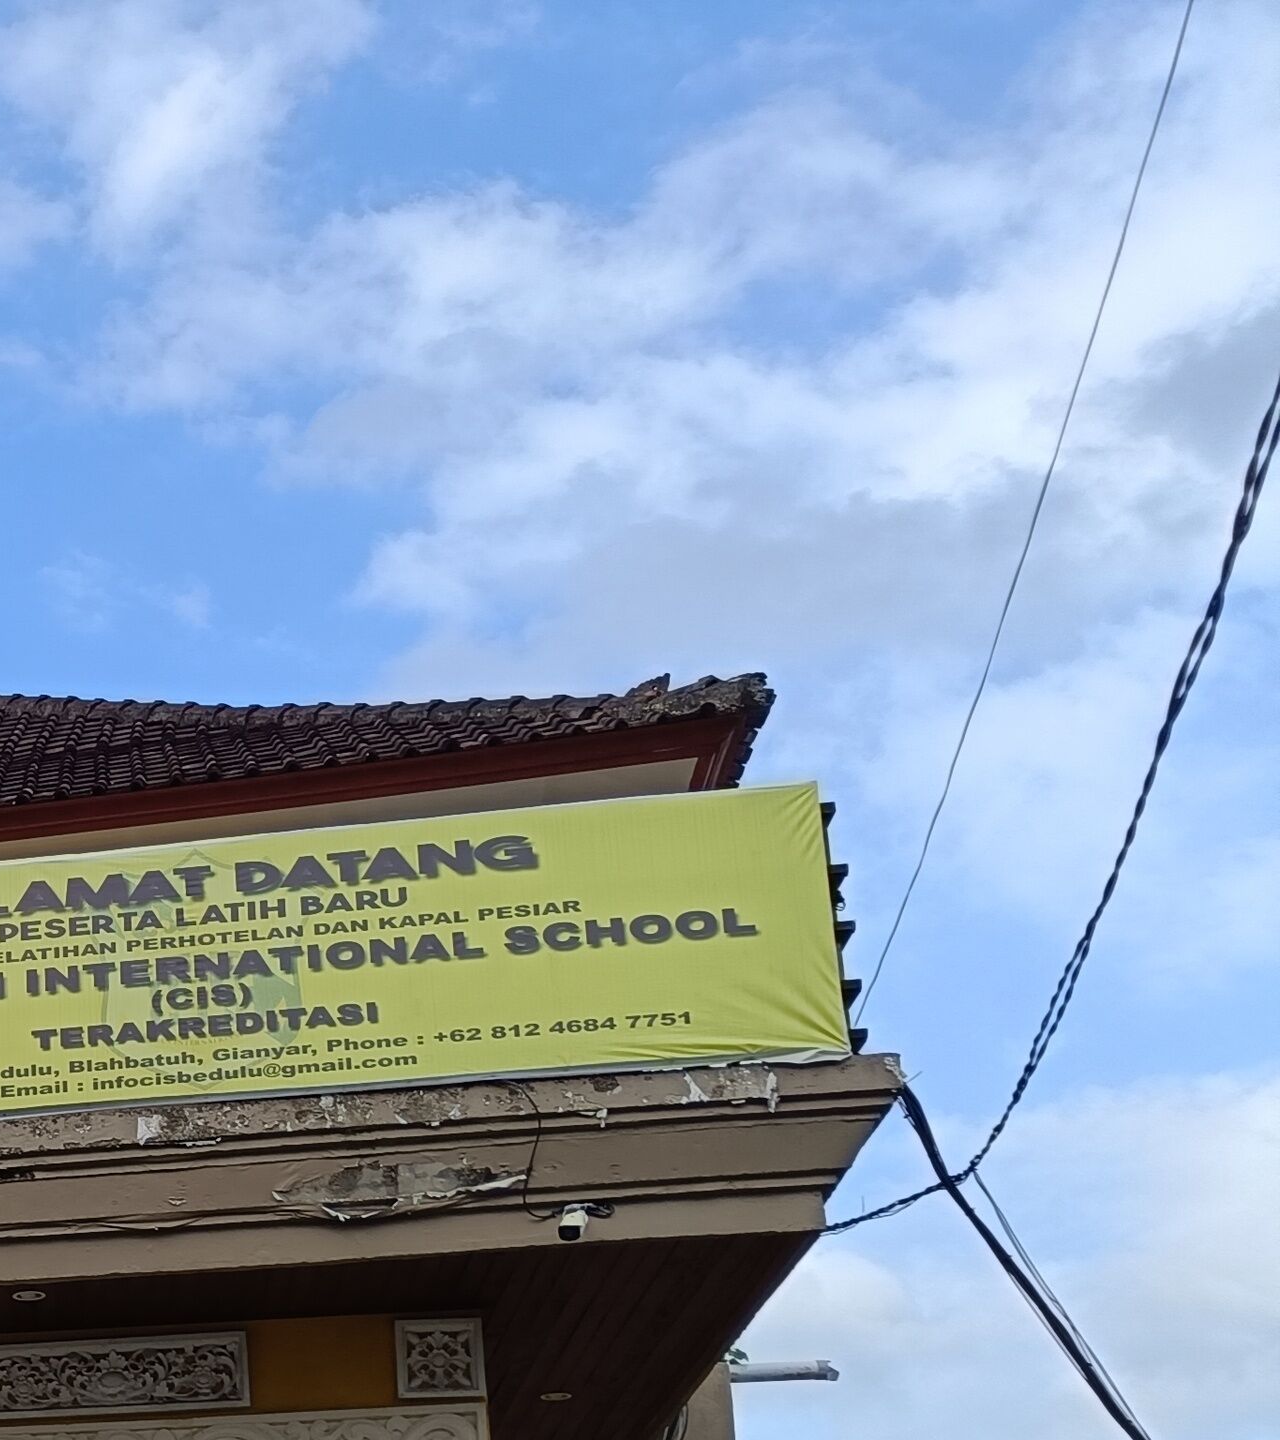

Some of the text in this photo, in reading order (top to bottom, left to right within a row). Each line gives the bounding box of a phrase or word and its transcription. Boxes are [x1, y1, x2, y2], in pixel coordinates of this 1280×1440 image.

[234, 835, 538, 895] DATANG
[126, 924, 304, 952] PERHOTELAN
[313, 919, 369, 936] DAN
[378, 910, 469, 930] KAPAL
[478, 900, 582, 921] PESIAR
[175, 898, 287, 927] LATIH
[300, 887, 408, 916] BARU
[26, 932, 485, 996] INTERNATIONAL
[503, 908, 759, 955] SCHOOL
[151, 983, 252, 1016] (CIS)
[31, 1002, 379, 1051] TERAKREDITASI
[69, 1051, 204, 1074] Blahbatuh,
[212, 1043, 318, 1062] Gianyar,
[326, 1033, 408, 1052] Phone
[433, 1026, 482, 1043] +62
[490, 1023, 541, 1040] 812
[548, 1016, 617, 1034] 4684
[625, 1011, 691, 1029] 7751
[0, 1079, 69, 1098] Email
[92, 1055, 418, 1091] infocisbedulu@gmail.com
